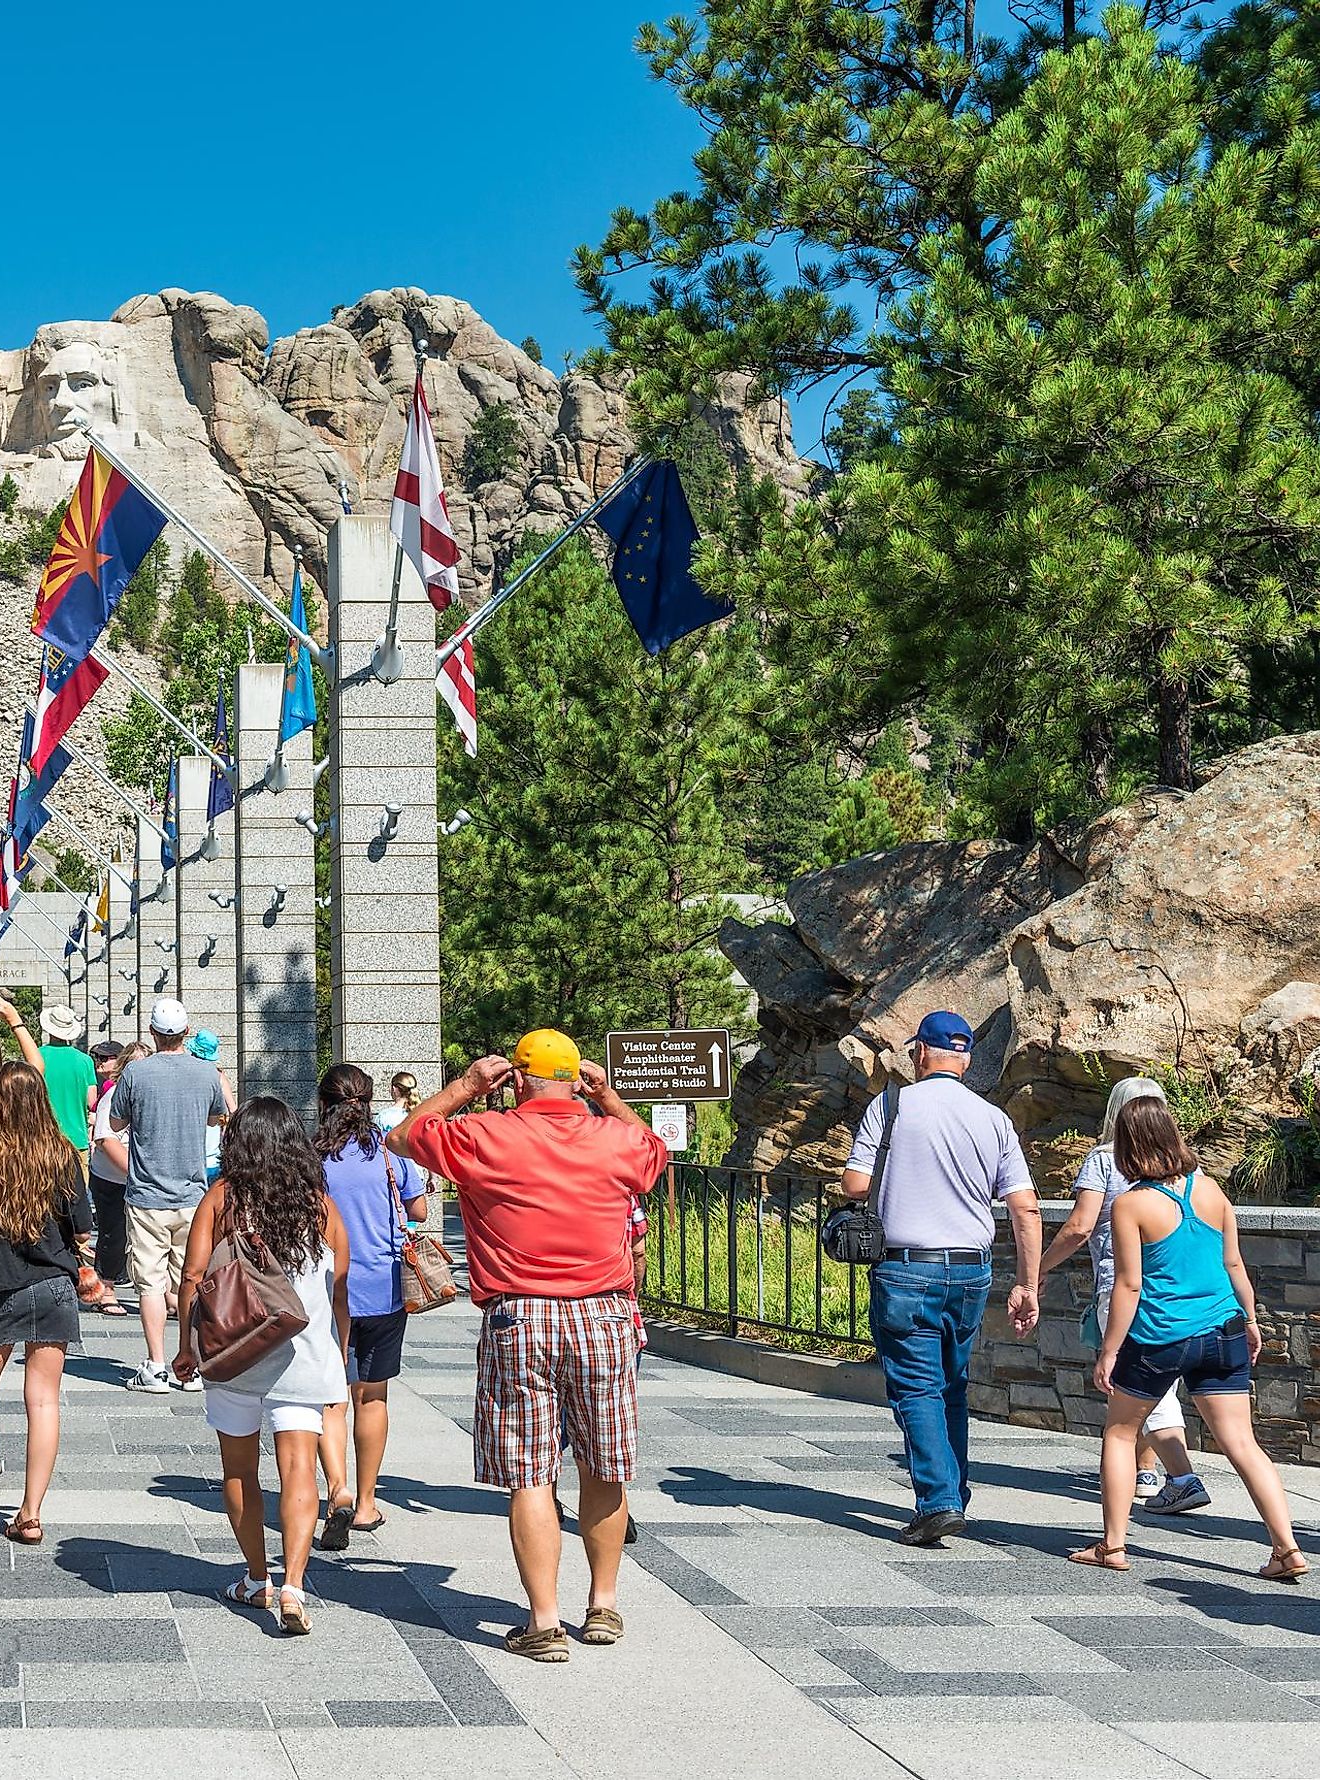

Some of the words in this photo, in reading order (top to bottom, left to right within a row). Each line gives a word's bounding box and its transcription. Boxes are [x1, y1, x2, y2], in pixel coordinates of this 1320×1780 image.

[621, 1042, 658, 1052] Visitor
[660, 1041, 696, 1051] Center
[623, 1054, 696, 1066] Amphitheater
[613, 1066, 678, 1077] Presidential
[680, 1065, 707, 1075] Trail
[615, 1079, 669, 1091] Sculptor's
[671, 1078, 707, 1088] Studio
